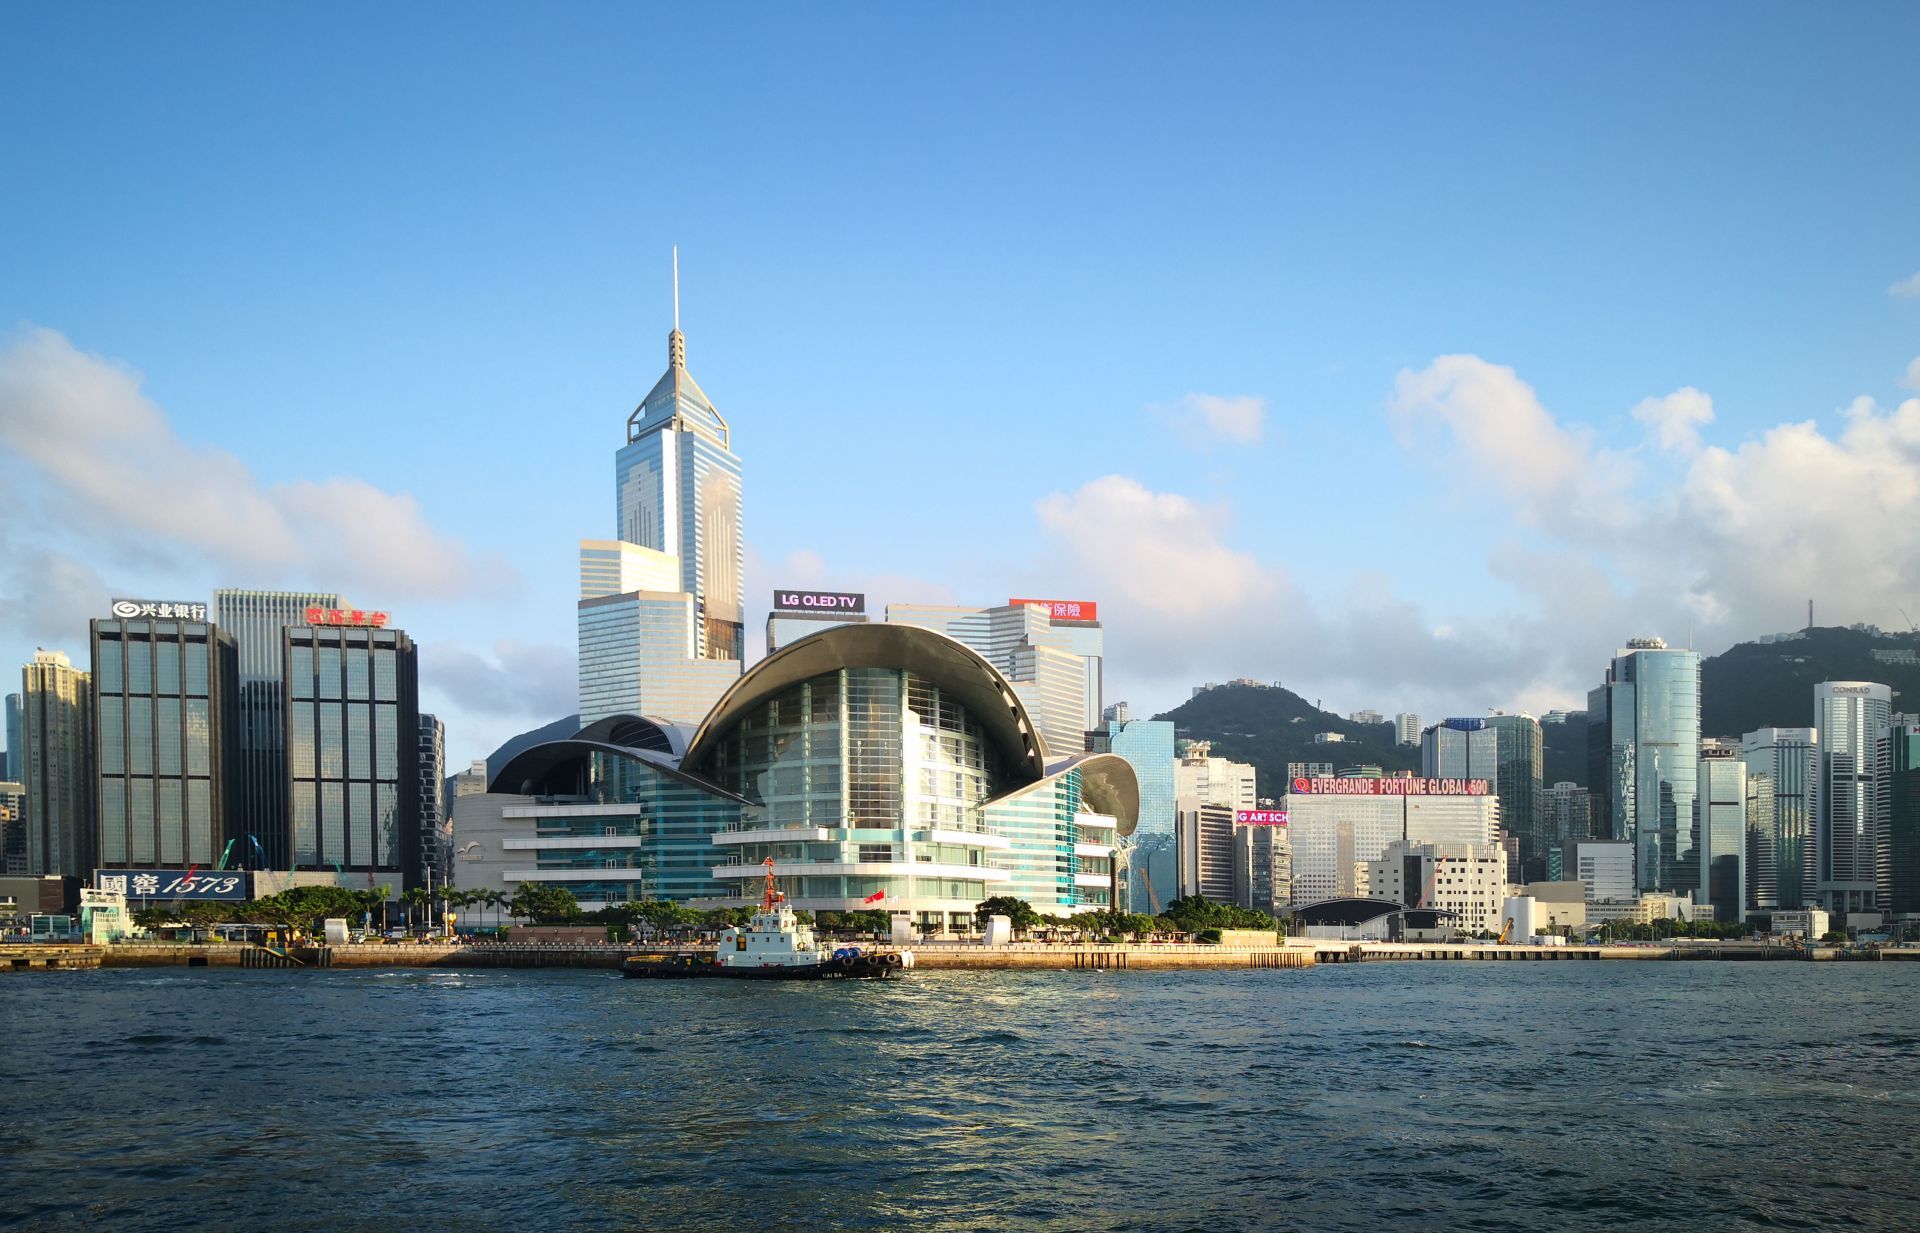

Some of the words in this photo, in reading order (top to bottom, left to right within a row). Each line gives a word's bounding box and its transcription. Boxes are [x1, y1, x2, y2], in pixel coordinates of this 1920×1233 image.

[782, 594, 800, 606] LG
[803, 595, 837, 607] OLED
[839, 596, 856, 608] TV
[140, 603, 206, 621] 兴业银行
[1833, 686, 1870, 694] CONRAD
[1311, 778, 1374, 794] EVERGRANDE
[1380, 778, 1426, 795] FORTUNE
[1428, 778, 1468, 795] GLOBAL
[1470, 779, 1488, 795] 500
[1237, 812, 1248, 821] G
[1250, 812, 1267, 822] ART
[100, 873, 160, 895] 國窖
[162, 876, 239, 893] 1573
